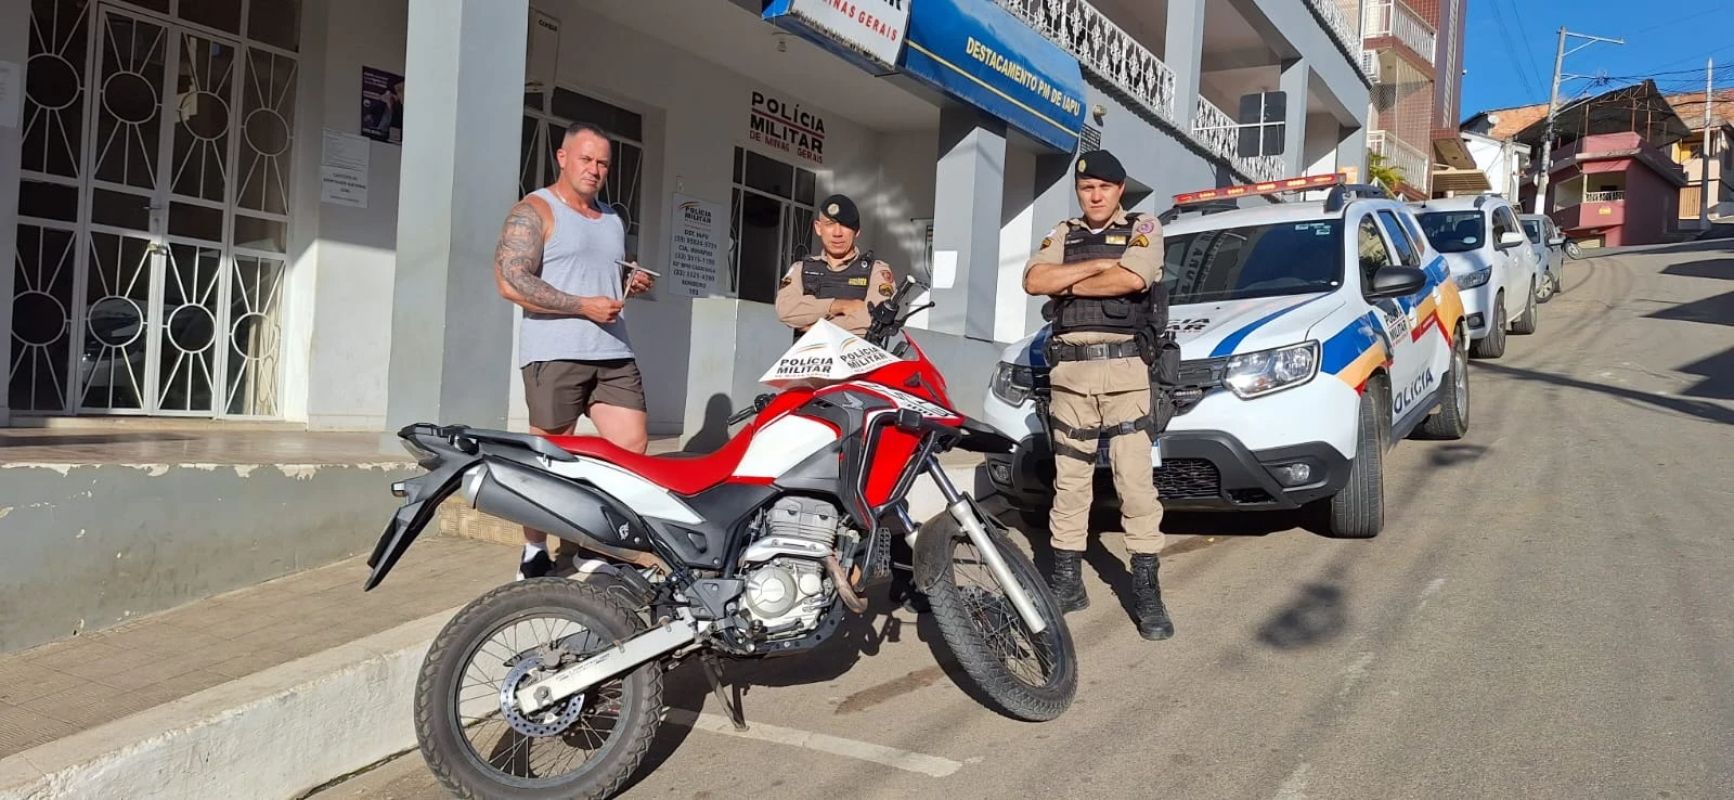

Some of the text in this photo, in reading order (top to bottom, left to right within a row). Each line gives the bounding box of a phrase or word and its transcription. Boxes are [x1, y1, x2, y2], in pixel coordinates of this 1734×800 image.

[858, 11, 897, 41] GERAIS
[965, 36, 1081, 117] DESTACAMENTO PM DE IAPU
[752, 91, 825, 133] POLÍCIA
[749, 130, 823, 164] DE MINAS GERAIS
[750, 113, 823, 154] MILITAR
[780, 356, 834, 367] POLÍCIA
[839, 346, 880, 362] POLÍCIA
[847, 352, 888, 369] MILITAR
[776, 365, 832, 374] MILITAR
